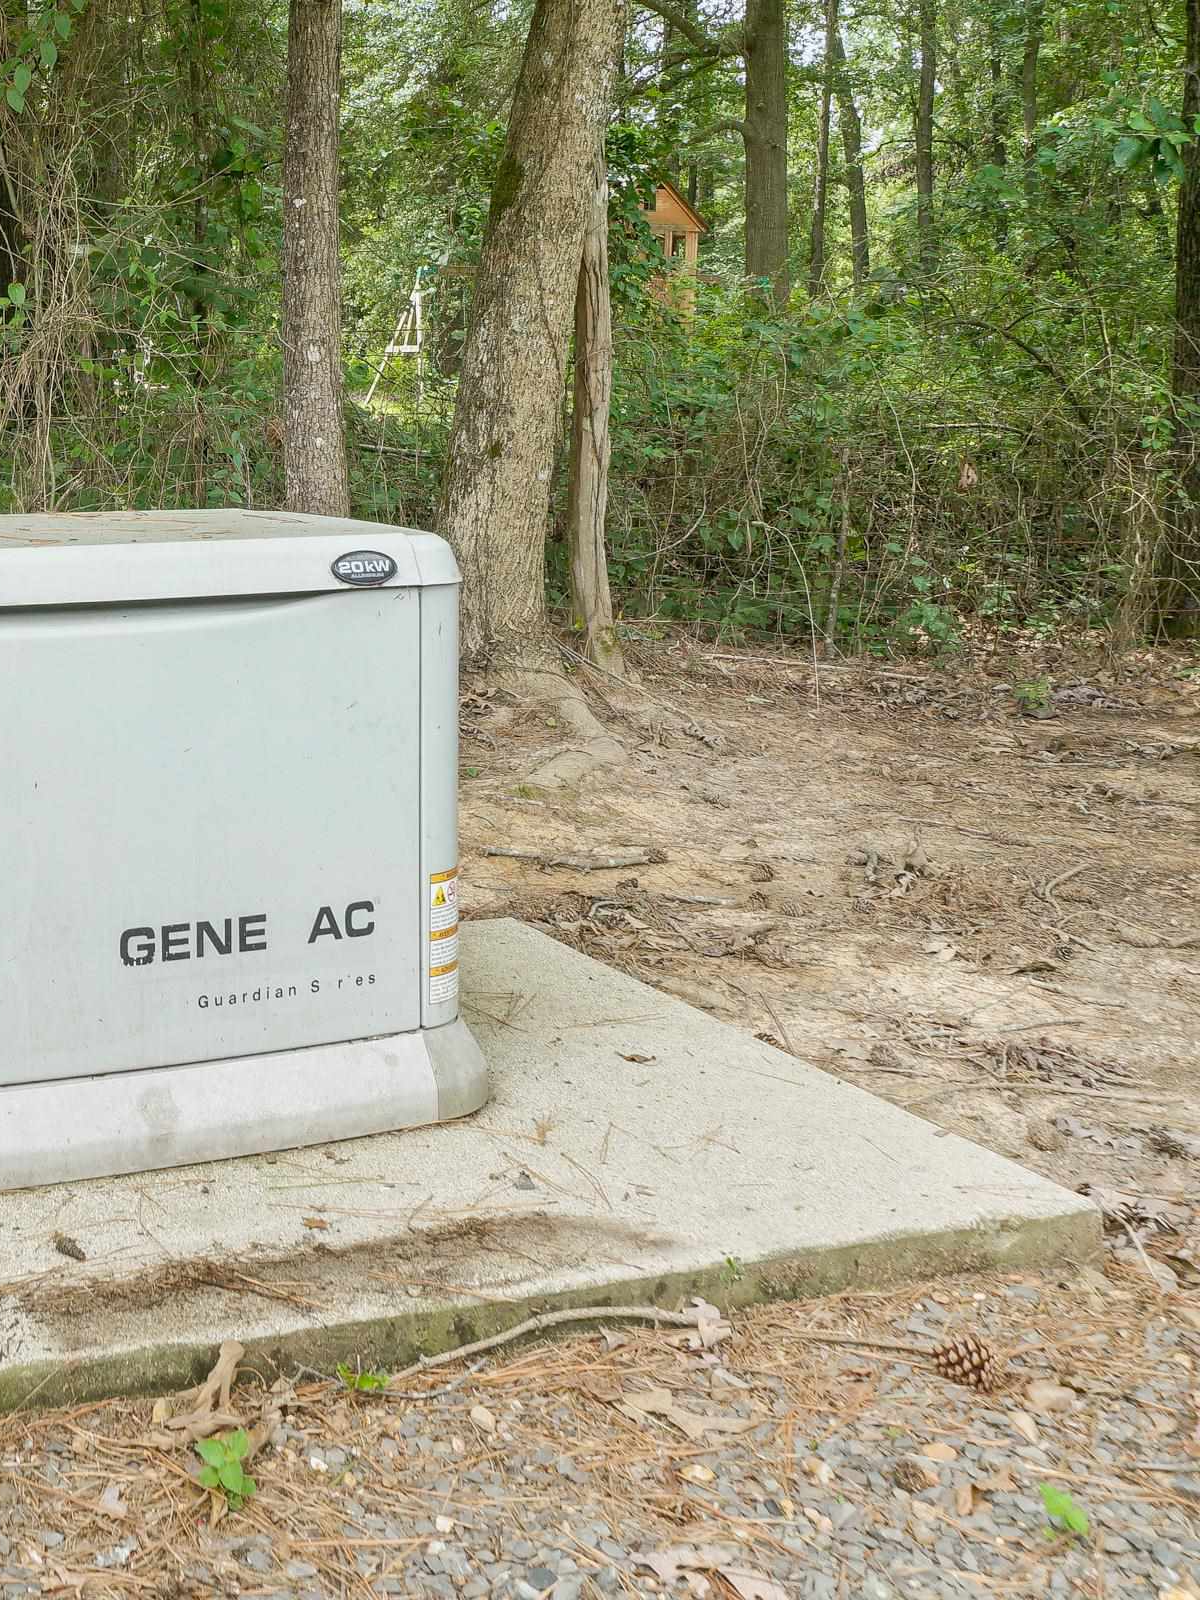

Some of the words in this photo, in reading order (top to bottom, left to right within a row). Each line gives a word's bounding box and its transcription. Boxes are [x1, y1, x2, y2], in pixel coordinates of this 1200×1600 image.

[119, 899, 376, 967] GENEAC
[197, 984, 298, 1009] Guardian
[310, 973, 377, 993] Sres
